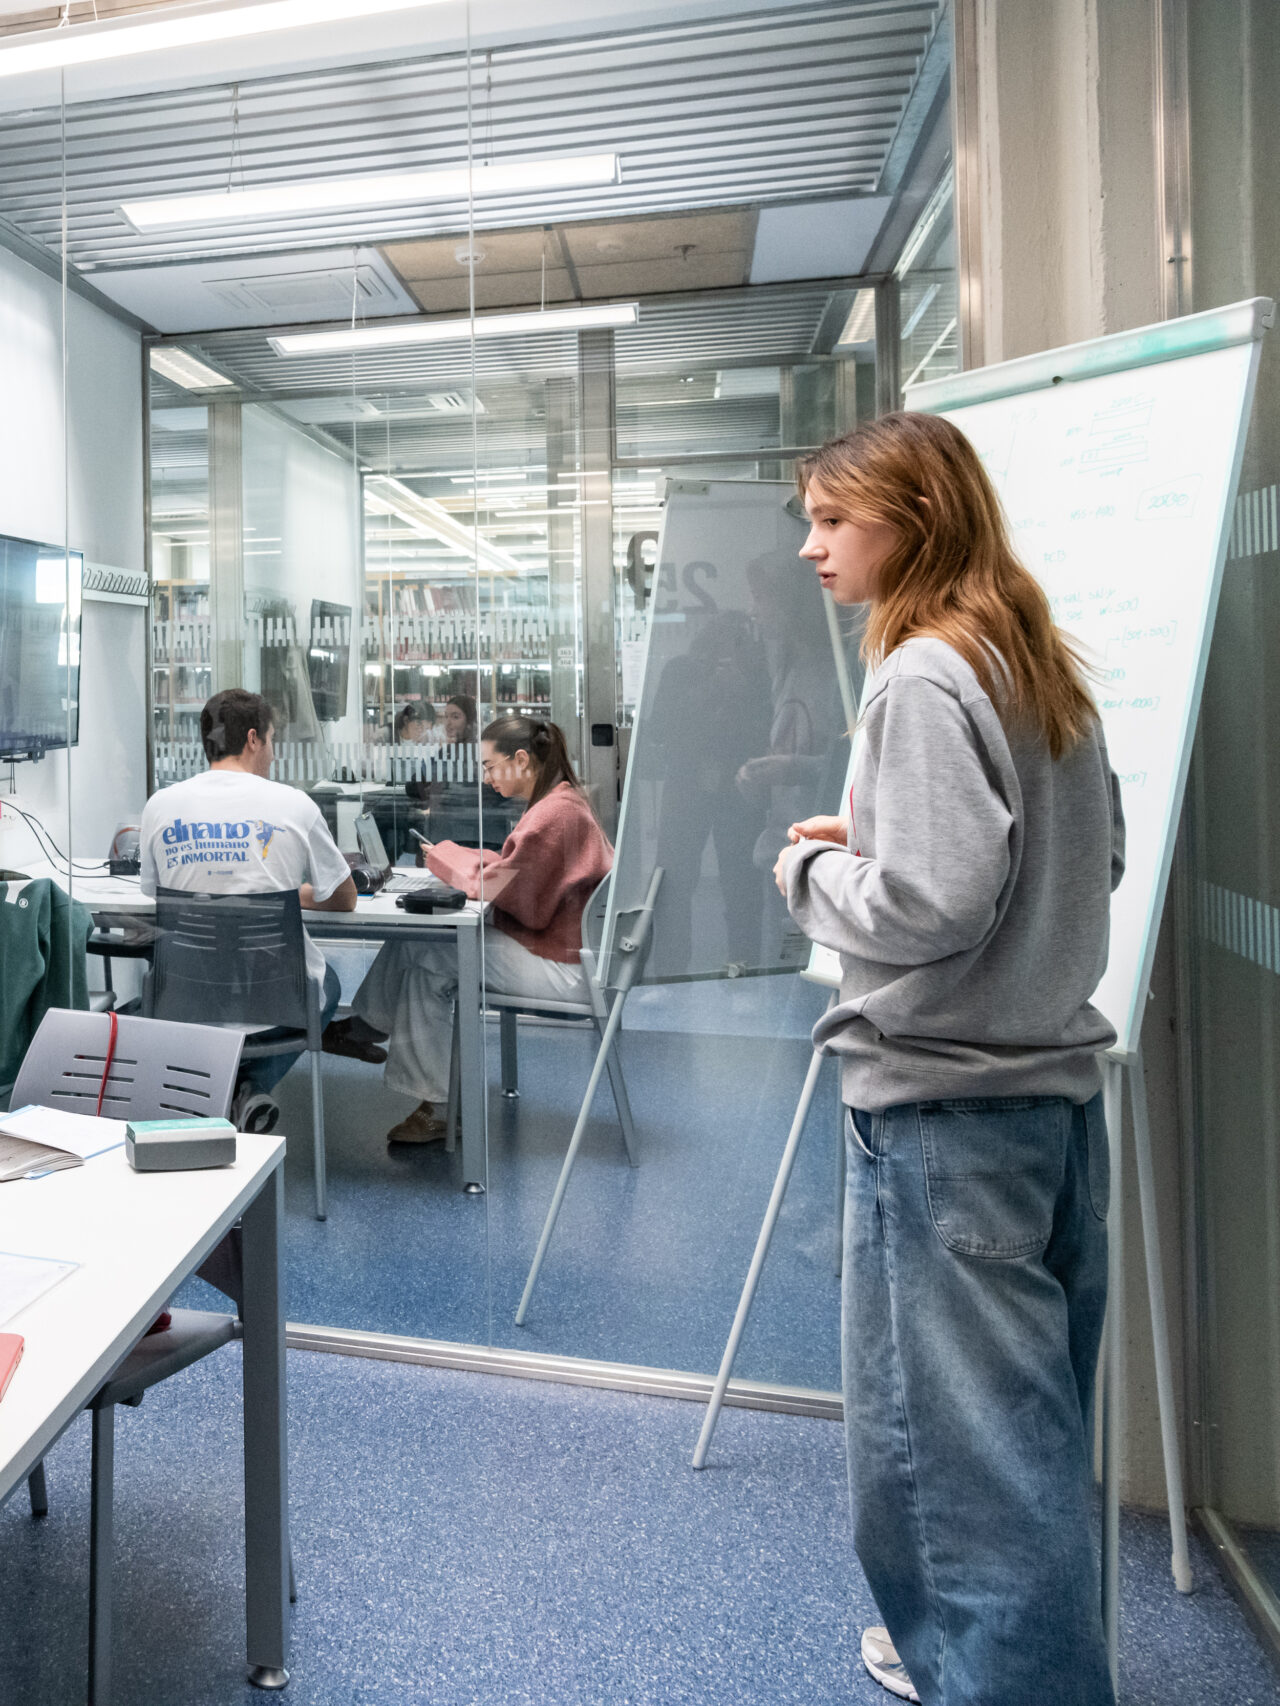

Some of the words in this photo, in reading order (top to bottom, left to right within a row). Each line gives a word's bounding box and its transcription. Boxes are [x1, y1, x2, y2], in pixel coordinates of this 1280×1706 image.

[165, 846, 178, 856] no
[195, 840, 249, 849] humano
[168, 856, 178, 869] ES
[181, 851, 249, 864] INMORTAL
